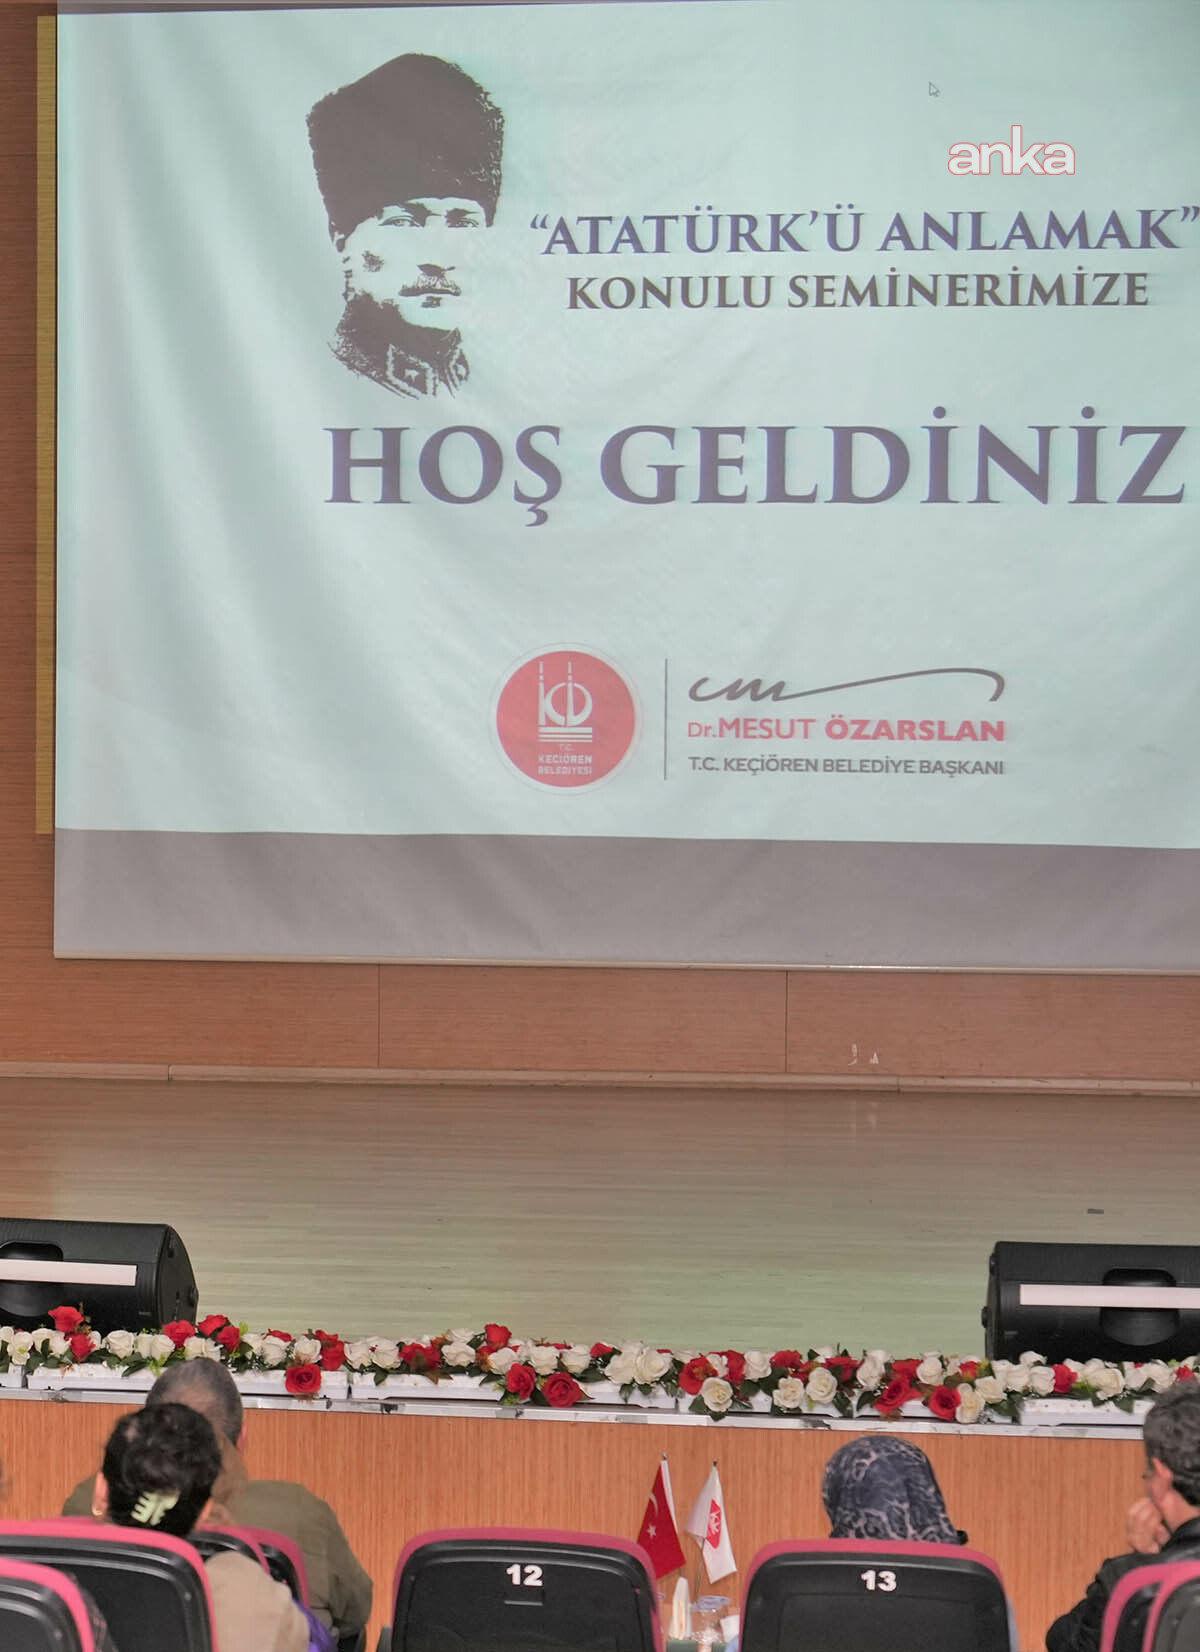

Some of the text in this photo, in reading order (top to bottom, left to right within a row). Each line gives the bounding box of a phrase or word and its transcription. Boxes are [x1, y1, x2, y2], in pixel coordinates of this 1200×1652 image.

[566, 265, 1150, 309] KONULU SEMİNERİMİZE
[322, 405, 1188, 528] HOŞ GELDİNİZ
[825, 714, 1006, 742] ÖZARSLAN
[688, 754, 1004, 779] T.C. KEÇİÖREN BELEDİYE BAŞKANI
[506, 1563, 543, 1586] 12
[861, 1569, 897, 1592] 13
